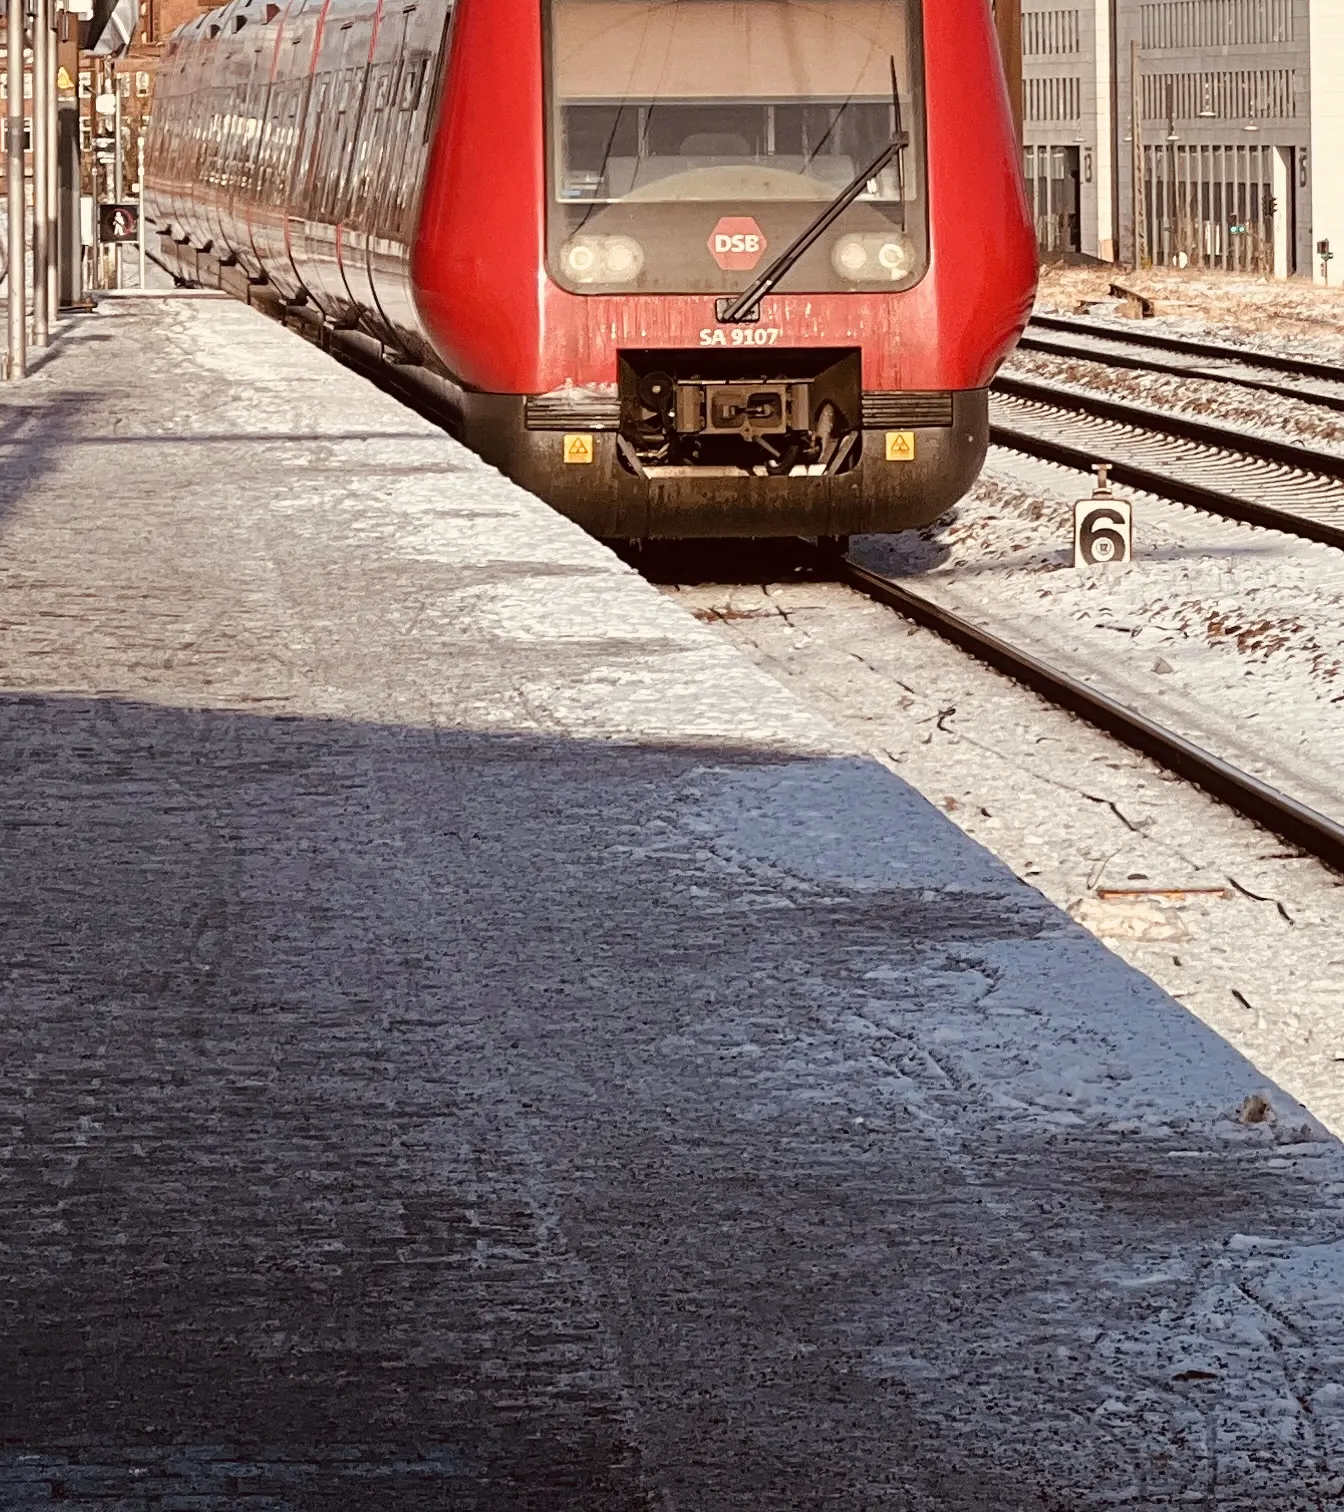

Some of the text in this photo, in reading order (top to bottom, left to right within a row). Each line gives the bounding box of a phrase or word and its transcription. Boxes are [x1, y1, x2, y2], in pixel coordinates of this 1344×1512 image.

[715, 234, 759, 253] DSB
[699, 327, 779, 346] SA 9107
[1080, 508, 1126, 565] 6
